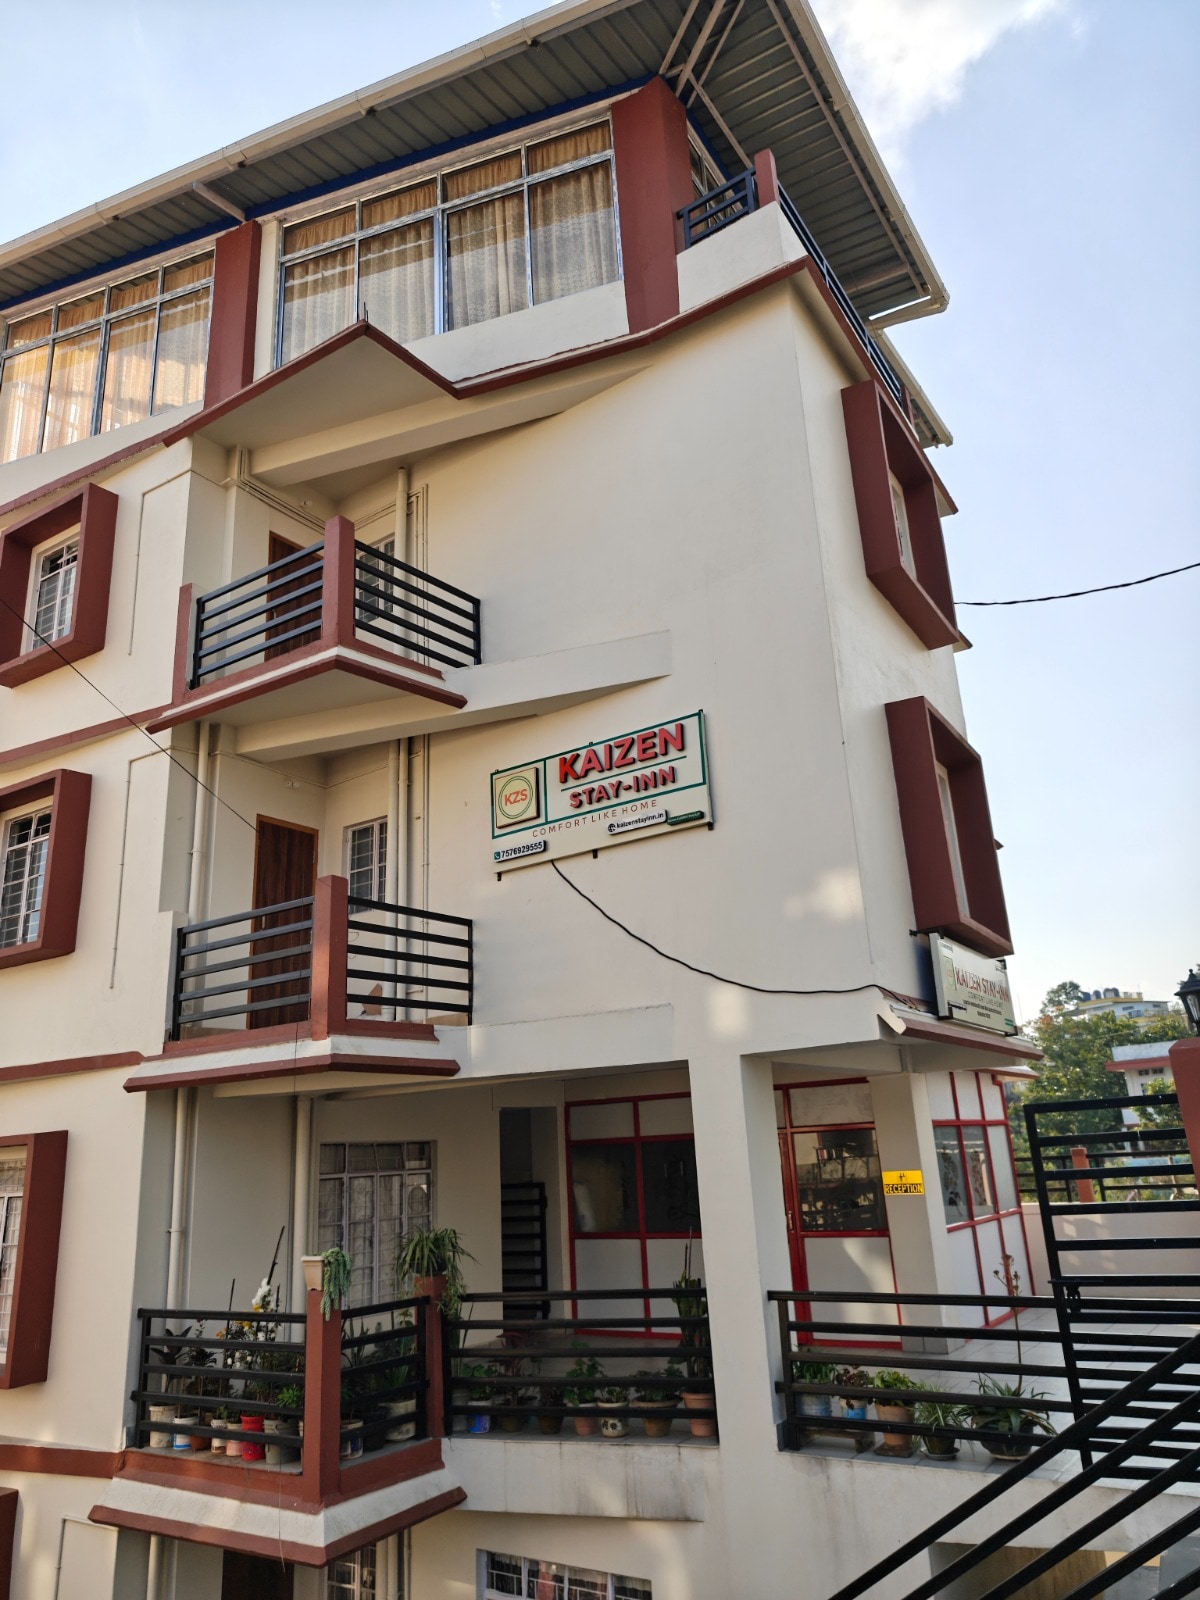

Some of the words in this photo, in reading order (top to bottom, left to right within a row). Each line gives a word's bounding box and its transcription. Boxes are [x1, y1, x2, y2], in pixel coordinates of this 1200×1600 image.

[559, 723, 685, 784] KAIZEN
[504, 788, 529, 807] KZS
[569, 766, 676, 809] STAY-INN
[532, 816, 588, 838] COMFORT
[591, 809, 618, 824] LIKE
[621, 799, 658, 815] HOME
[616, 813, 665, 830] kaizenstayinn.in
[500, 842, 543, 858] 7576929555
[955, 967, 981, 992] KAIZEN
[885, 1184, 923, 1194] RECEPTION
